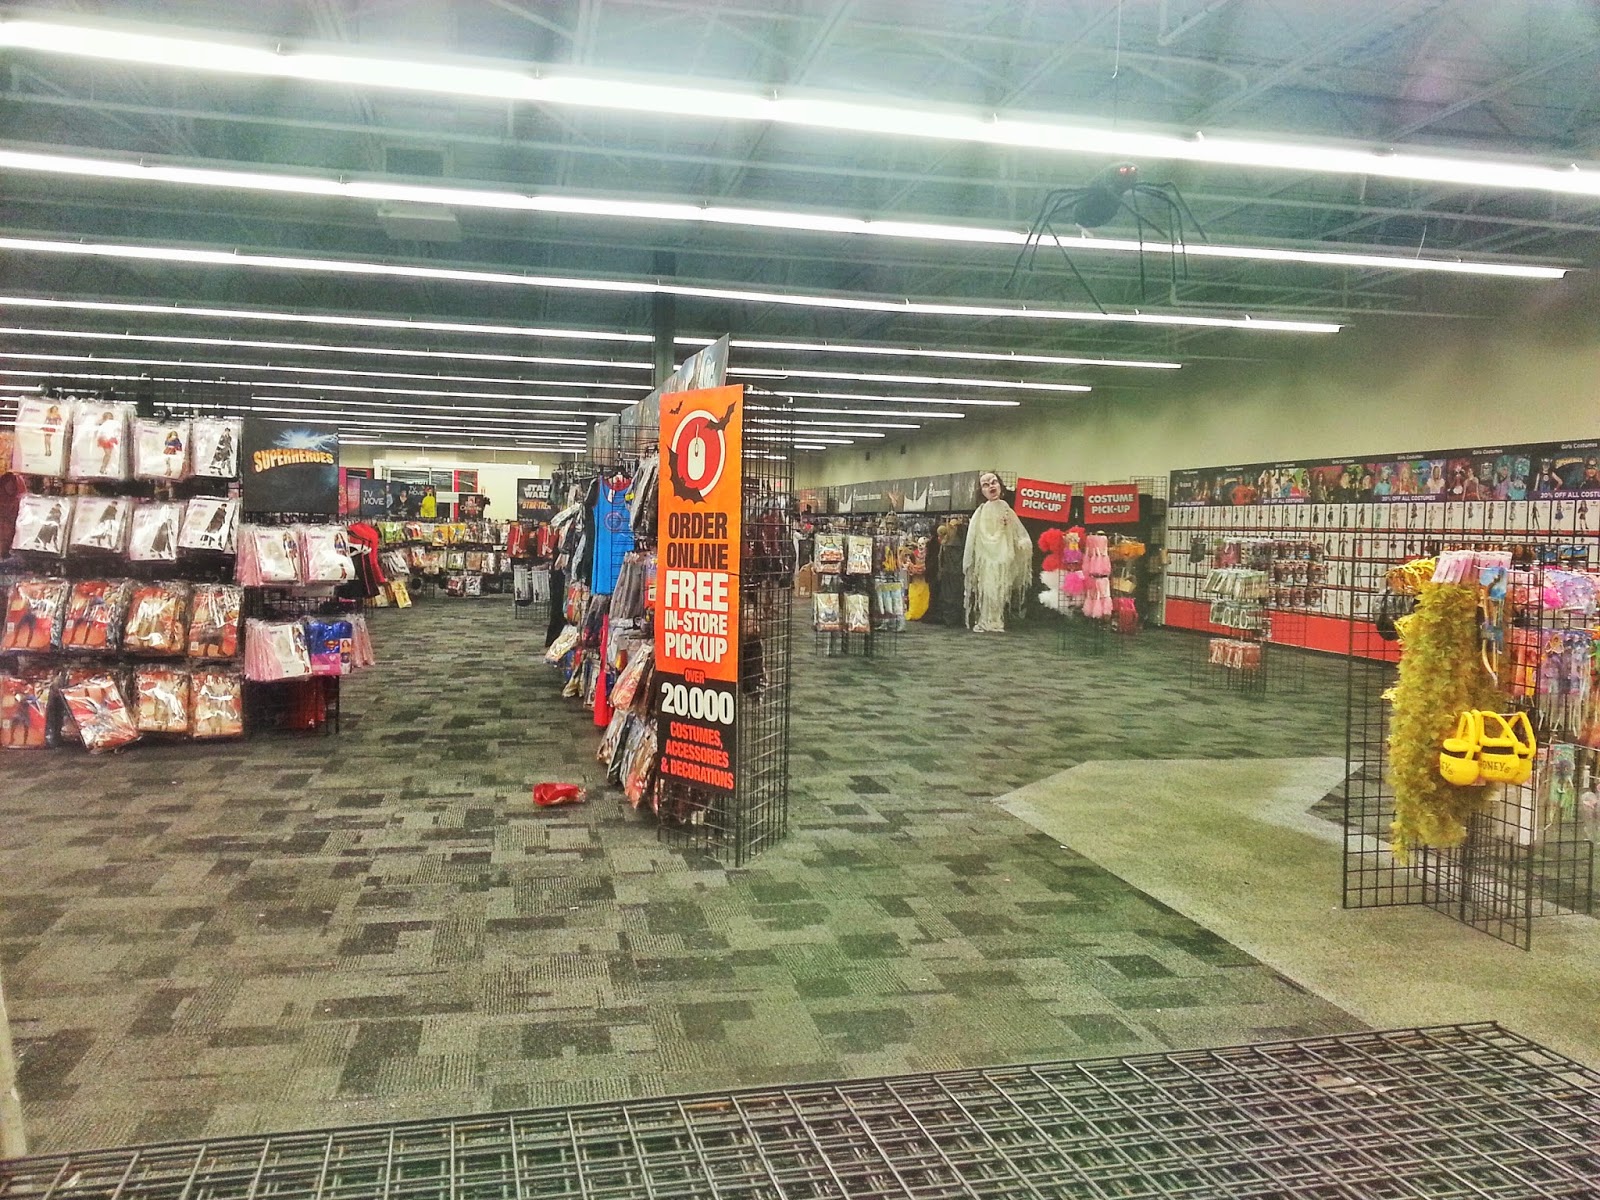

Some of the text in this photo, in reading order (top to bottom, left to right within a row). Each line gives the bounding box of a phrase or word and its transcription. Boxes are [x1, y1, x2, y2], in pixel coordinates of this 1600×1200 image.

[253, 448, 335, 473] SUPERHEROES
[363, 489, 373, 498] TV
[523, 484, 550, 492] STAR
[1020, 488, 1067, 502] COSTUME
[1088, 493, 1134, 504] COSTUME
[1022, 499, 1062, 512] PICK-UP
[1091, 504, 1131, 514] PICK-UP
[668, 512, 728, 539] ORDER
[666, 543, 729, 570] ONLINE
[665, 570, 729, 612] FREE
[664, 610, 728, 636] IN-STORE
[664, 632, 728, 663] PICKUP
[685, 669, 705, 684] OVER
[661, 682, 734, 725] 20,000
[670, 721, 723, 749] COSTUMES,
[665, 739, 729, 768] ACCESSORIES
[1481, 760, 1506, 771] ONEY
[660, 756, 734, 789] & DECORATIONS
